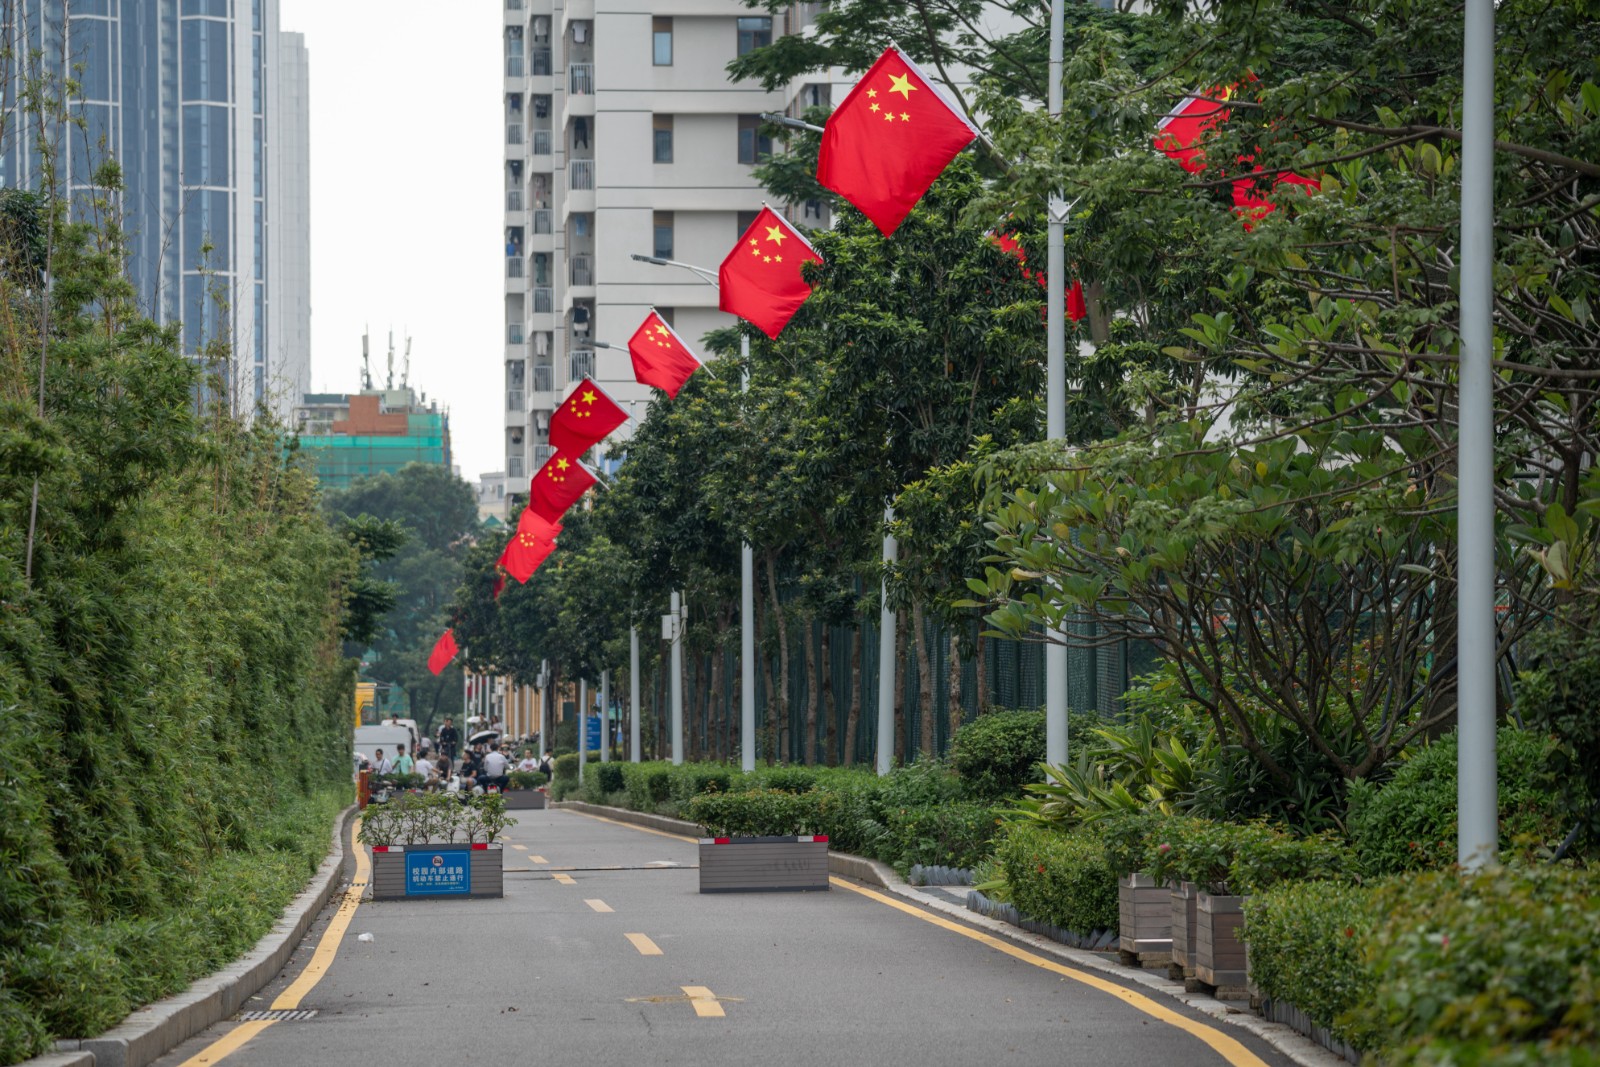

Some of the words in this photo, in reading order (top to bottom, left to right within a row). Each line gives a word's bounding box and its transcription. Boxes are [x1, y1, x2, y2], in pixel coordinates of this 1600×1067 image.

[412, 867, 463, 875] 校园内部道路
